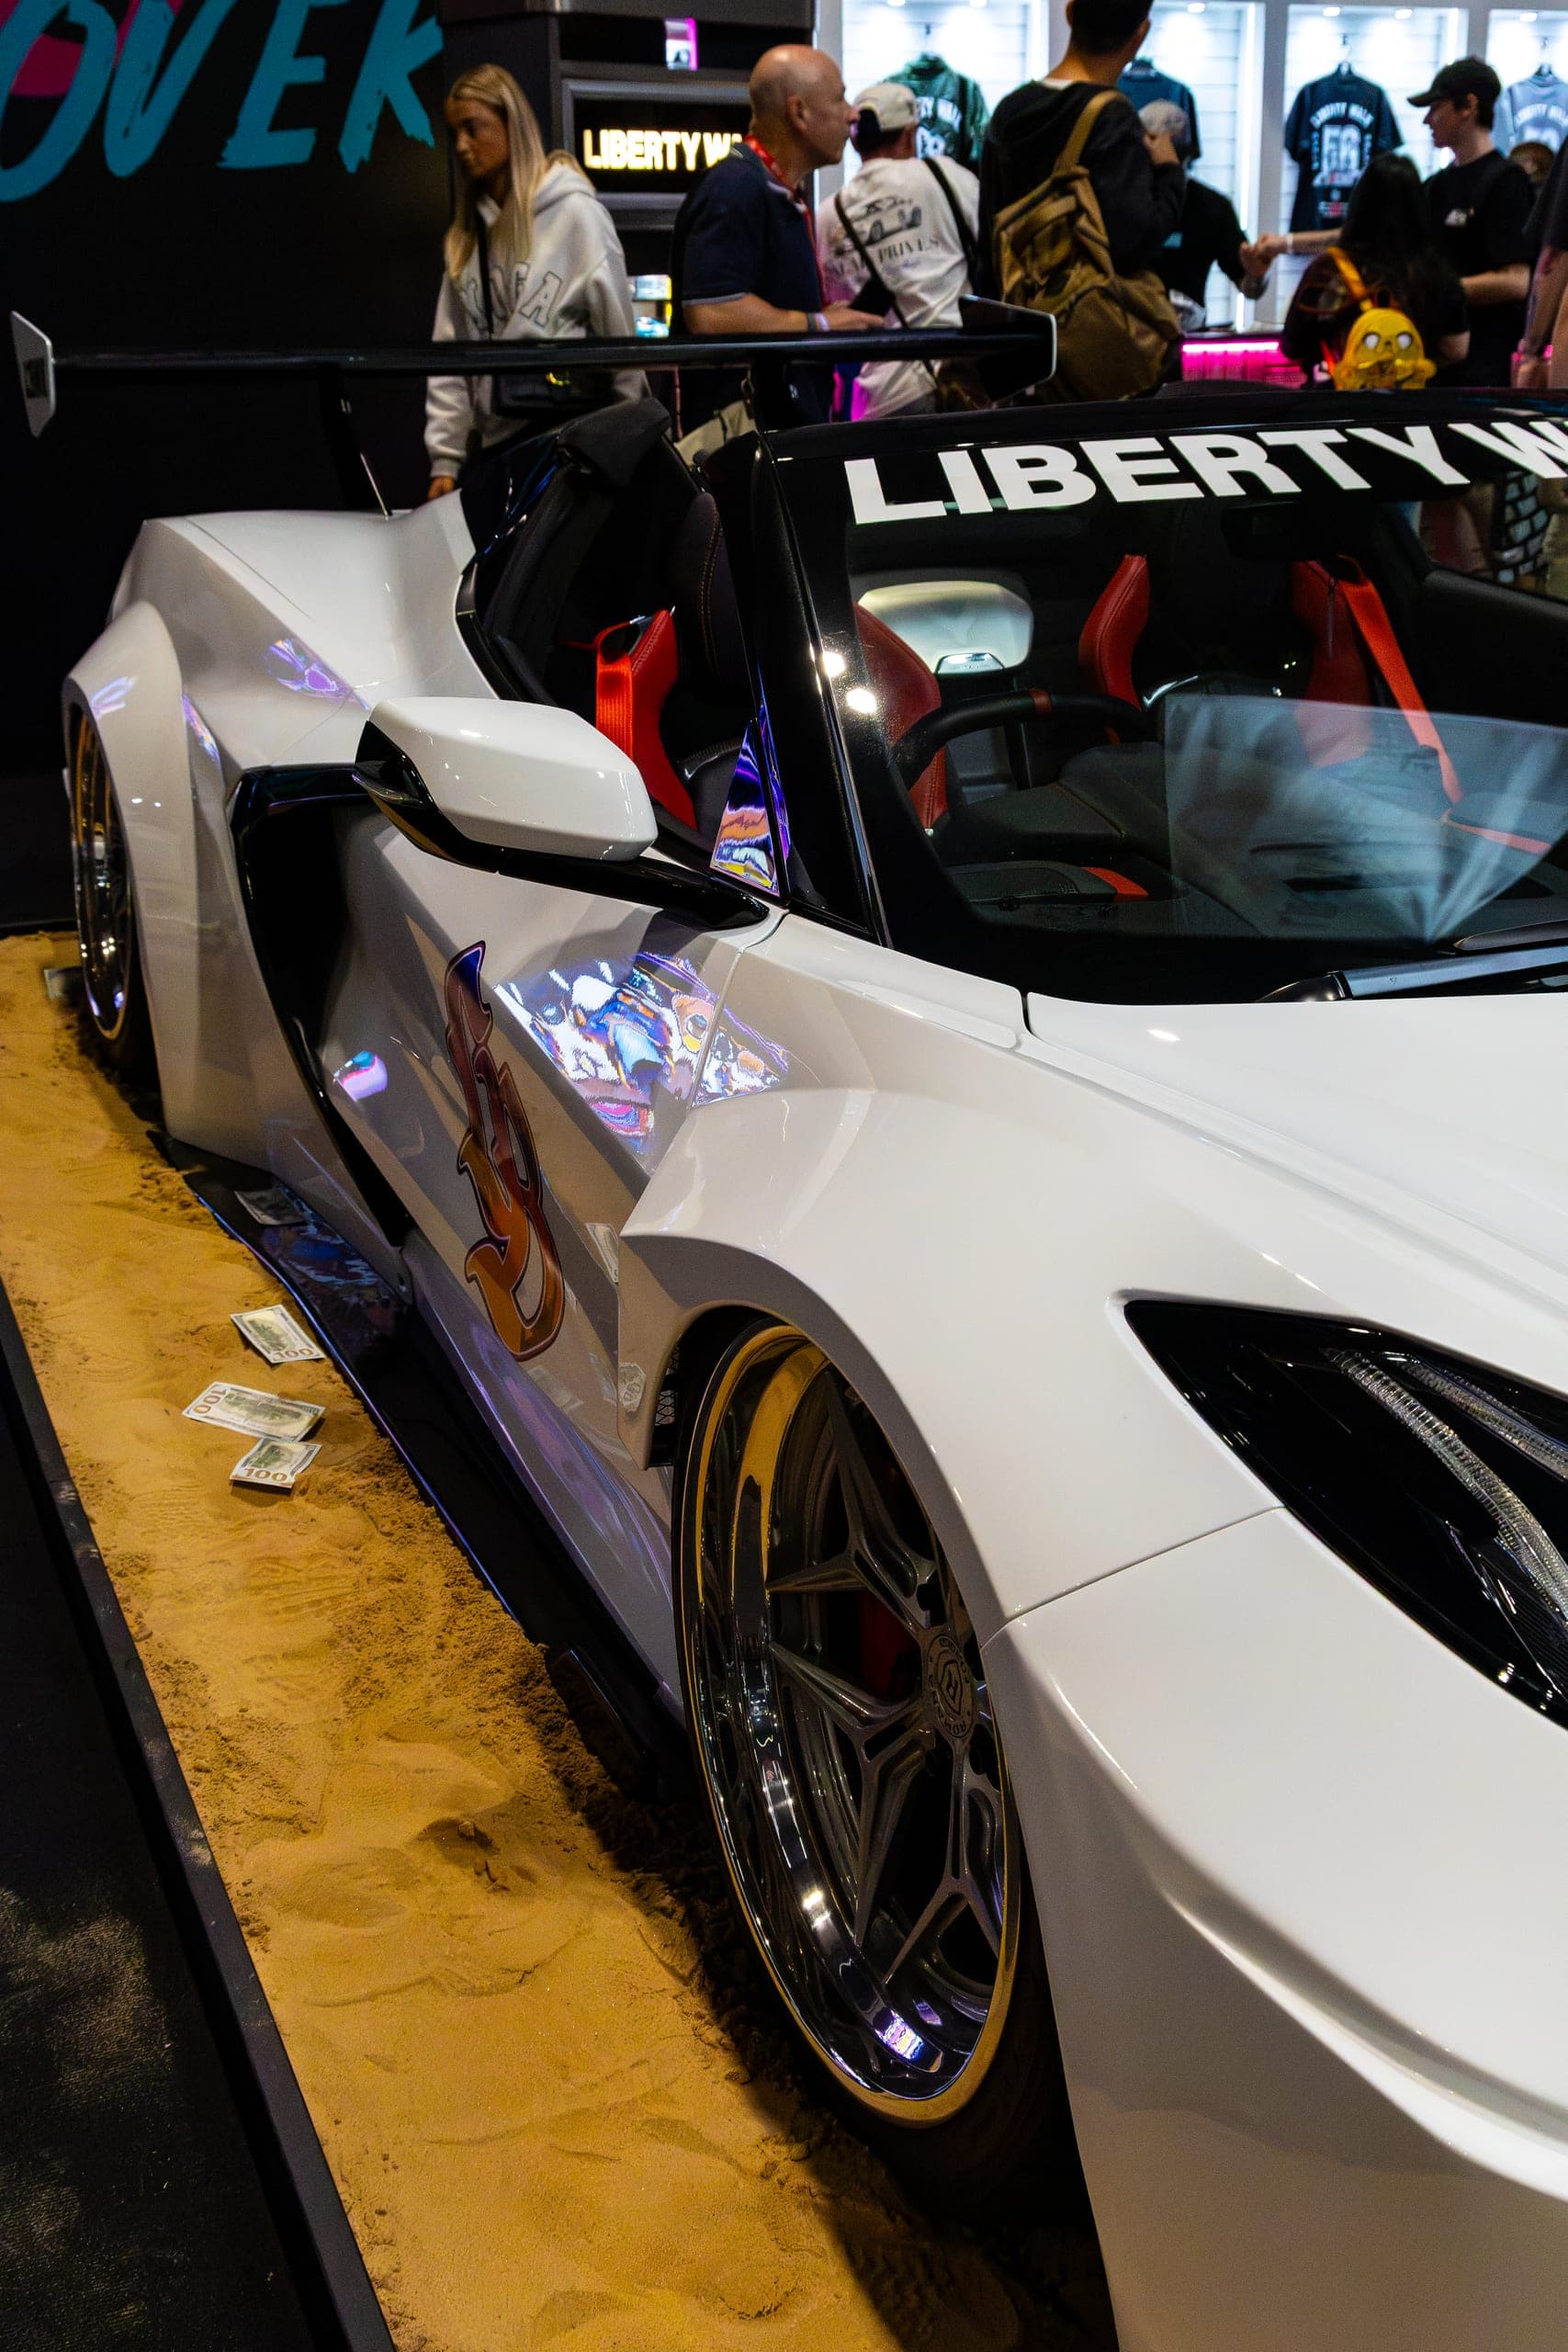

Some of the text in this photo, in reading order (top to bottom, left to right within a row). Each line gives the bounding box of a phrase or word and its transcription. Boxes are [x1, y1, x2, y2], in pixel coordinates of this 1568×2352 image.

[582, 129, 701, 172] LIBERTY
[844, 421, 1568, 525] LIBERTY W
[243, 1467, 288, 1483] 100
